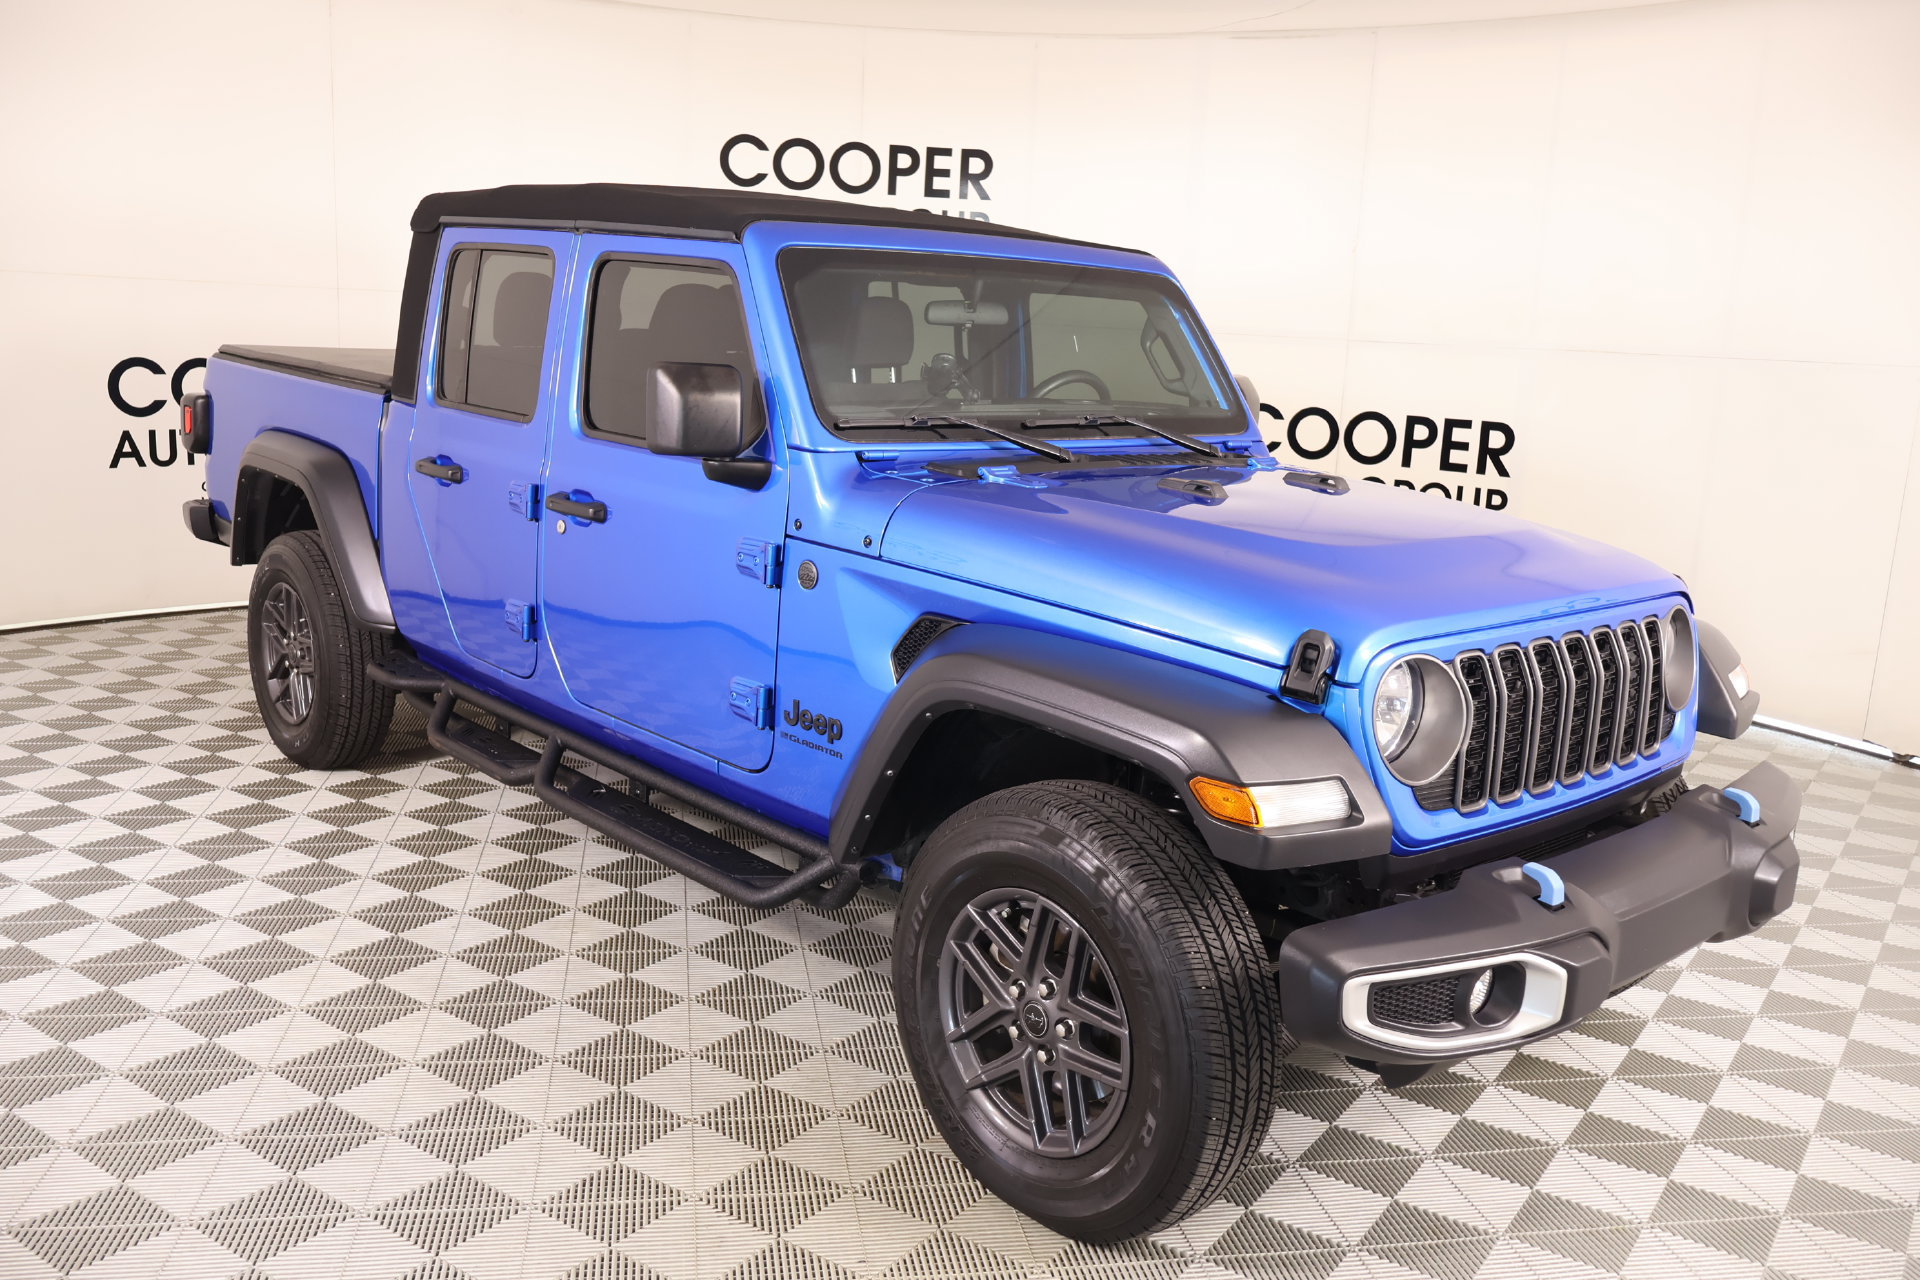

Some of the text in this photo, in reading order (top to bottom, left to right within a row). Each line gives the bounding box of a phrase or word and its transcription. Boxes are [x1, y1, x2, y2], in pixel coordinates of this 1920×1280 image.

[719, 133, 994, 201] COOPER
[108, 429, 196, 469] AU
[783, 698, 843, 745] Jeep
